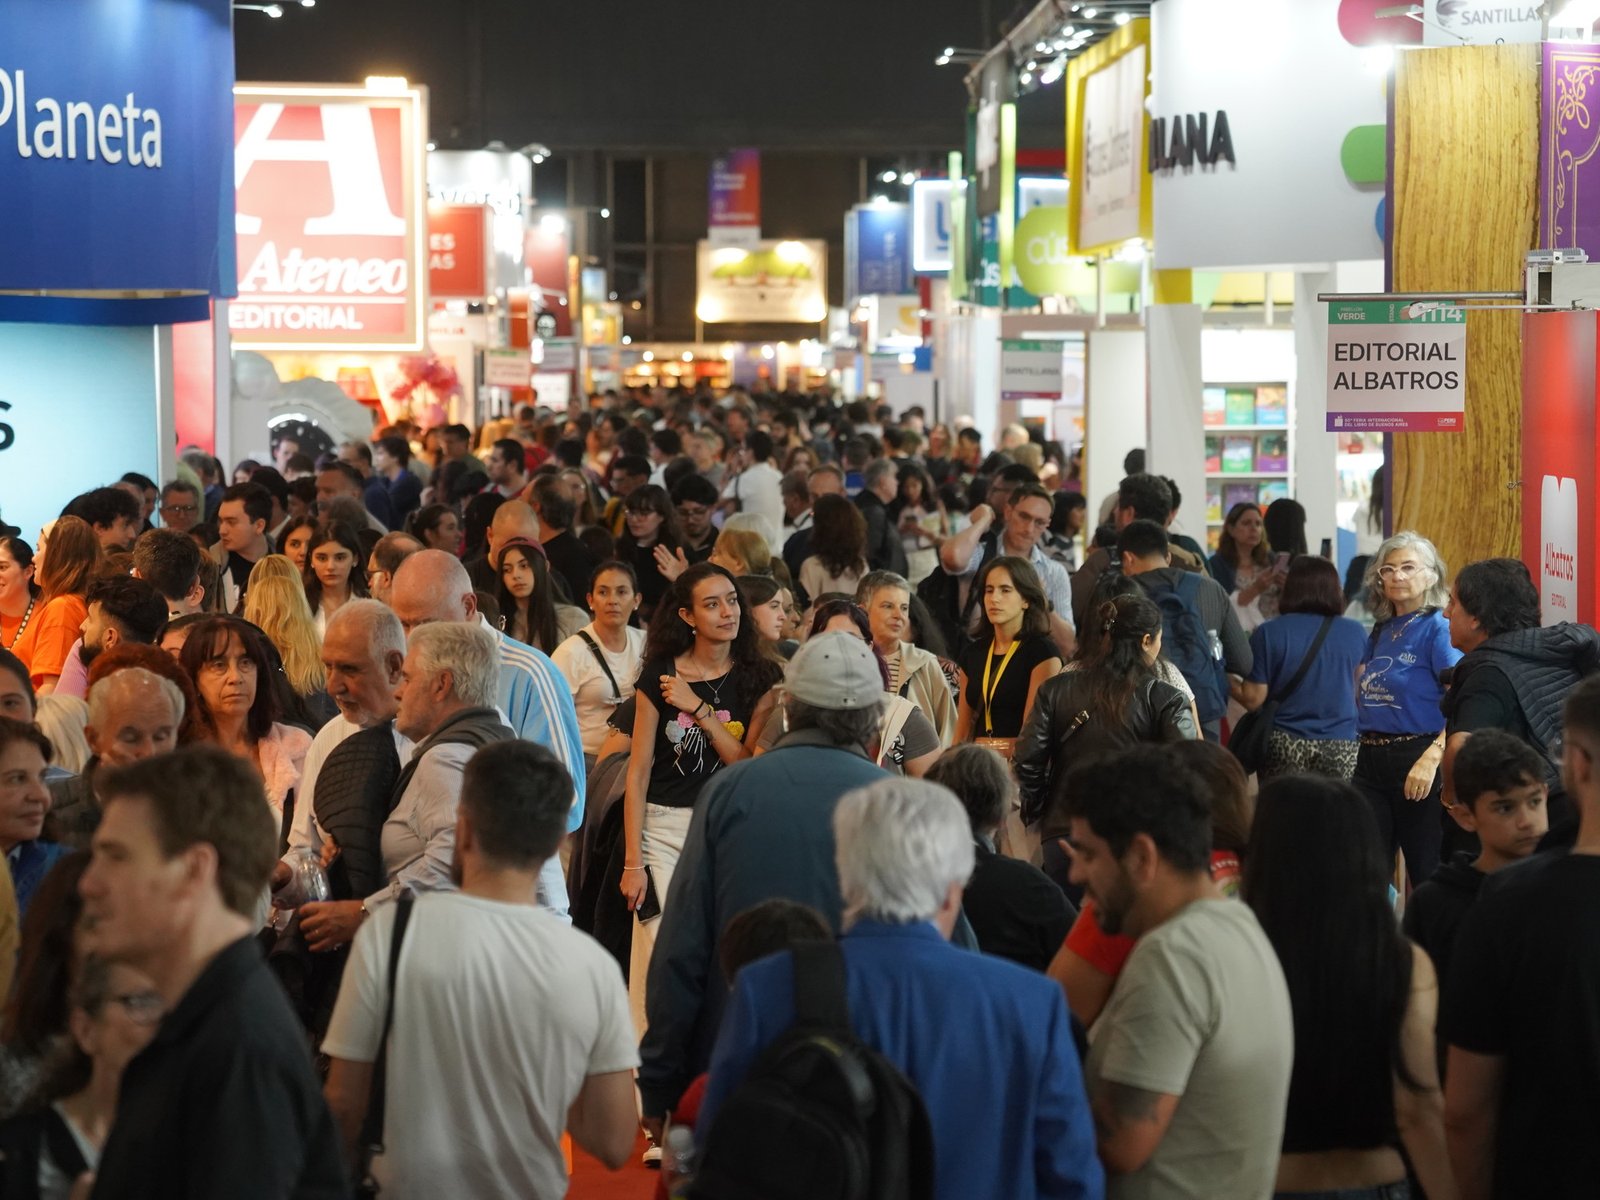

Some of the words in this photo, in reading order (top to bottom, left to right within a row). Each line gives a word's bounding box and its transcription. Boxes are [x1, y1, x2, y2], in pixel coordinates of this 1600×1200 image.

[1461, 7, 1541, 26] SANTILLA
[237, 240, 408, 294] Ateneo
[228, 304, 364, 330] EDITORIAL
[1337, 312, 1366, 320] VERDE
[1334, 342, 1457, 362] EDITORIAL
[1333, 371, 1459, 390] ALBATROS
[1544, 542, 1574, 582] Albatros
